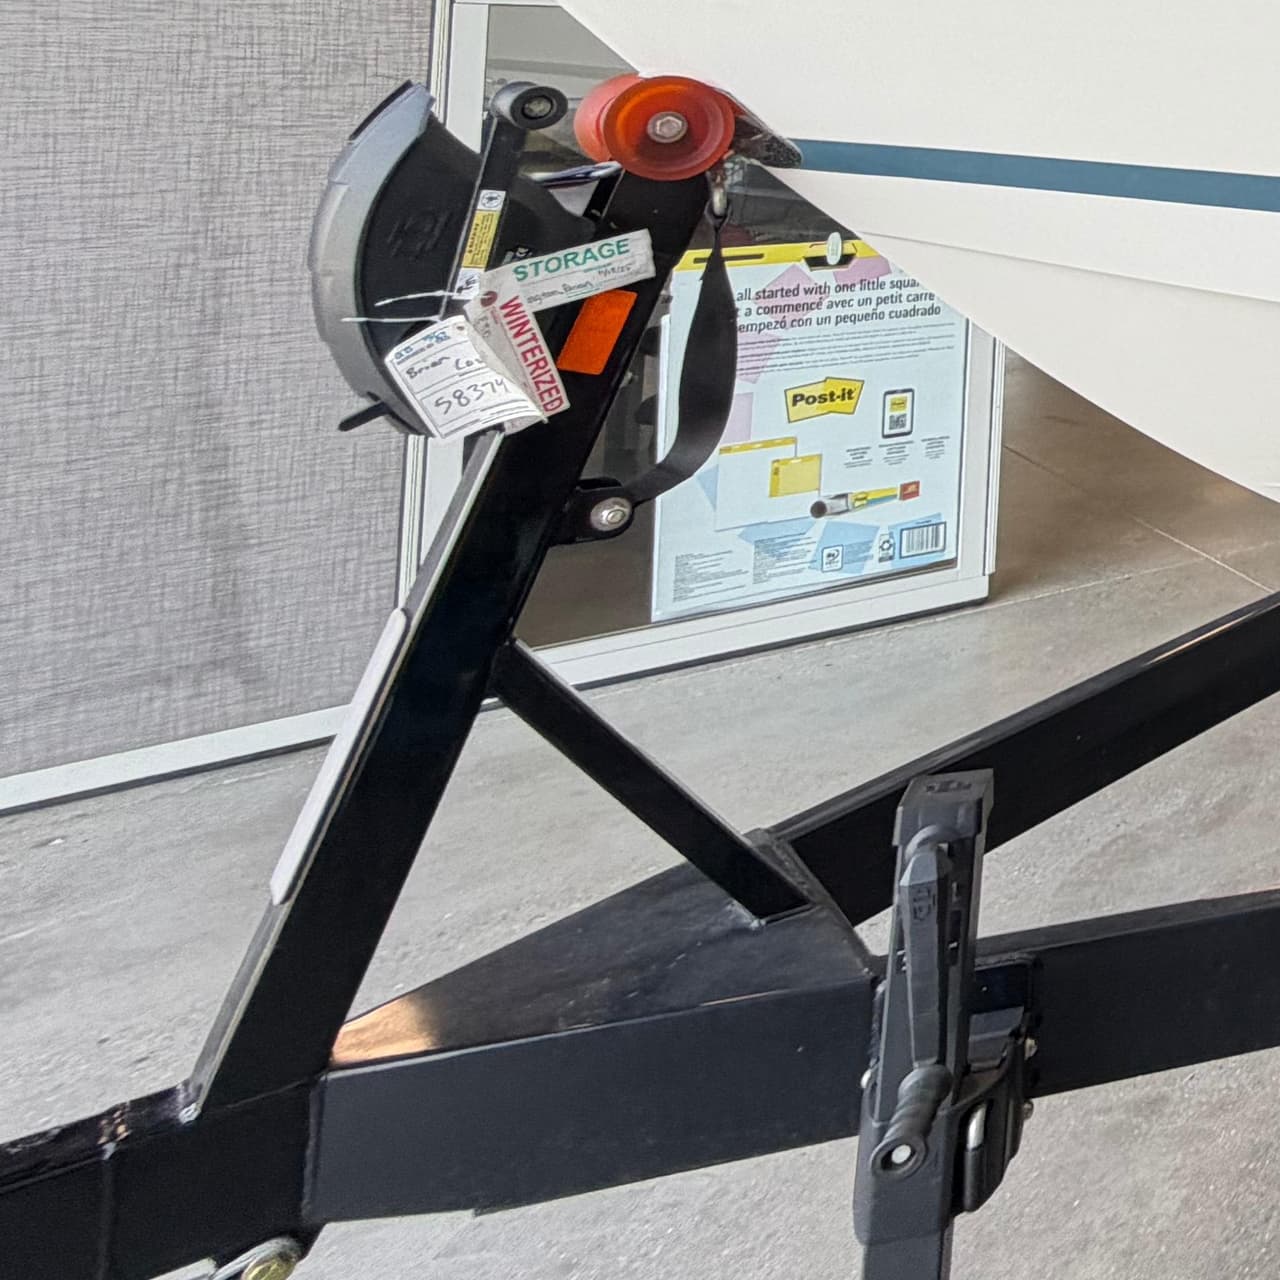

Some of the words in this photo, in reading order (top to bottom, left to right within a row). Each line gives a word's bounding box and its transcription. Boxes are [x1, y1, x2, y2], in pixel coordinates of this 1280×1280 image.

[513, 239, 630, 282] STORAGE
[736, 287, 751, 302] all
[755, 283, 800, 301] started
[803, 281, 831, 297] with
[834, 282, 856, 294] one
[859, 278, 886, 292] little
[744, 307, 753, 317] a
[756, 299, 824, 316] commencé
[826, 297, 854, 310] avec
[857, 296, 873, 307] un
[875, 292, 903, 309] petit
[737, 314, 788, 334] empezó
[790, 317, 813, 329] con
[816, 314, 832, 326] un
[835, 306, 885, 326] pequeño
[888, 303, 942, 320] cuadrado
[499, 295, 566, 414] WINTERIZED
[434, 378, 512, 415] 58374
[791, 386, 857, 408] Post-it
